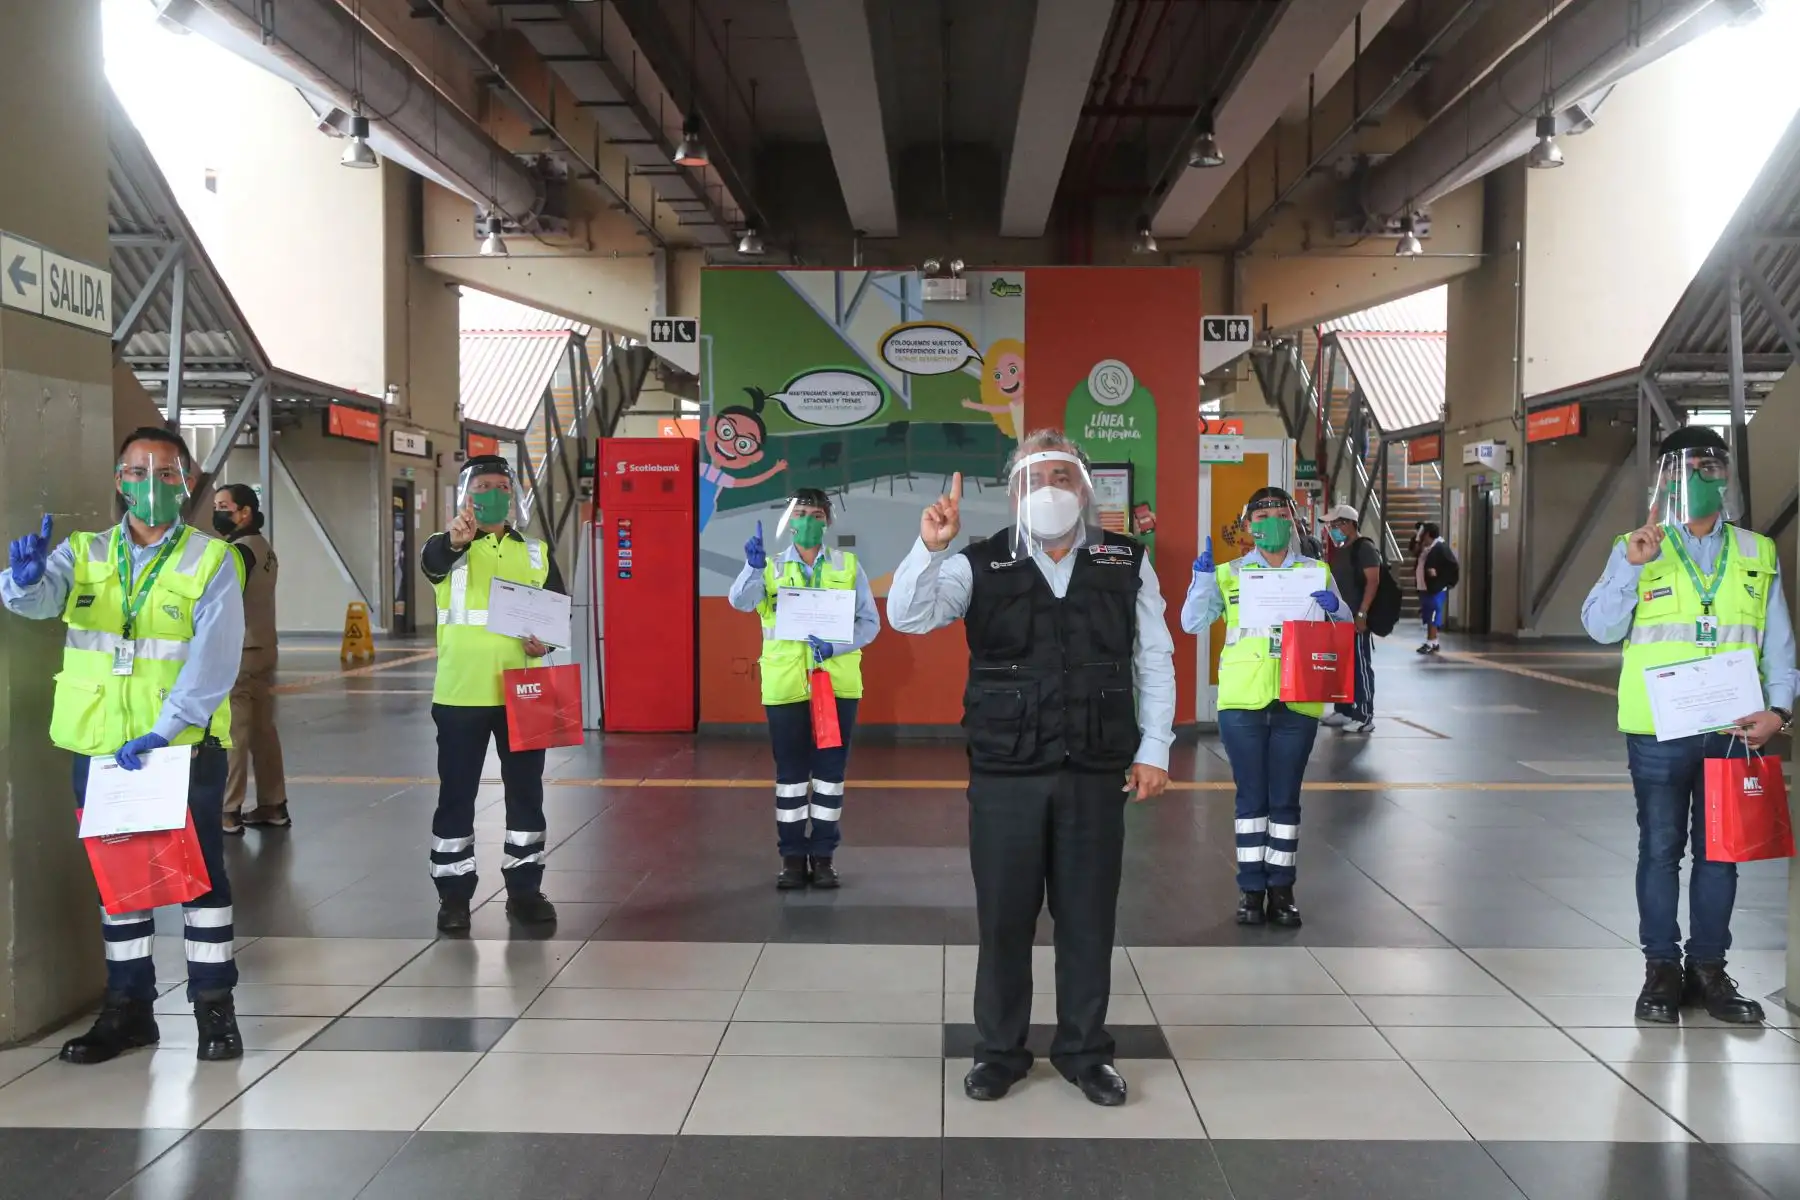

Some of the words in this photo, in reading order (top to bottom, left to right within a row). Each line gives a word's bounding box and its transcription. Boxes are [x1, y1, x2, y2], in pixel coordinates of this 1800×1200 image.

[49, 262, 105, 321] SALIDA
[1090, 411, 1124, 428] LÍNEA
[1128, 416, 1135, 428] 1
[1098, 427, 1142, 443] informa
[629, 464, 680, 472] Scotiabank
[1295, 464, 1317, 473] ALIDA
[516, 683, 541, 694] MTC
[1743, 776, 1762, 790] MT
